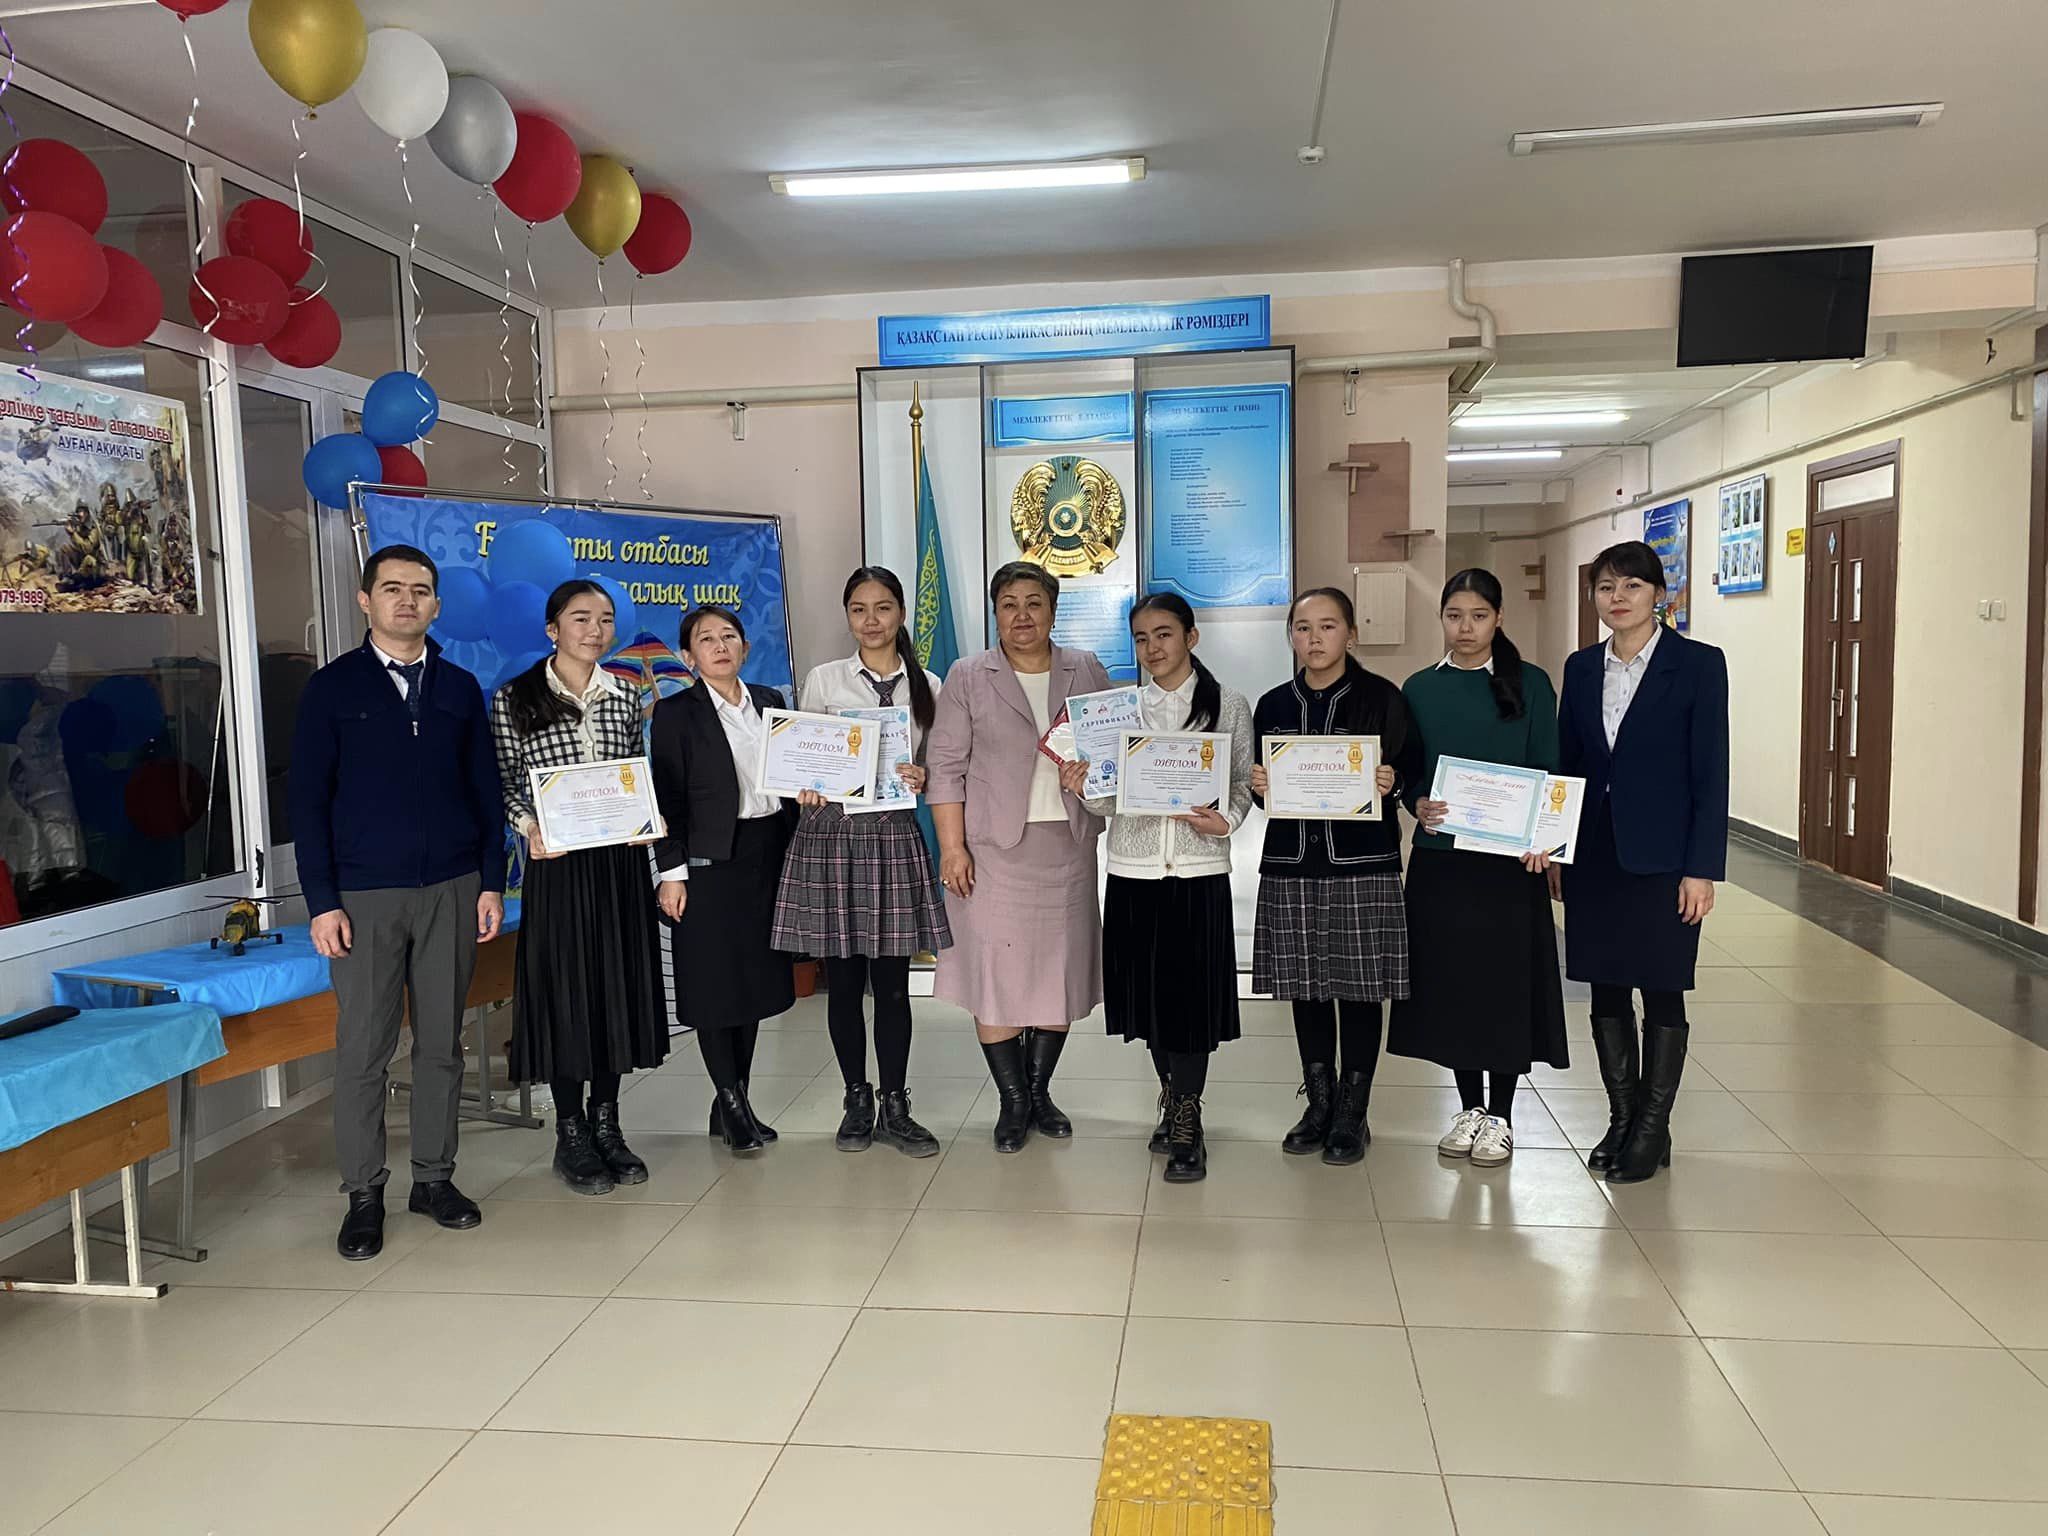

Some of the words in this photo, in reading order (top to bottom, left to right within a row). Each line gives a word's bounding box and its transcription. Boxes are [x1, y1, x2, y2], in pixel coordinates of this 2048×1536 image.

[897, 329, 964, 346] ҚАЗАҚСТАН
[967, 318, 1094, 342] РЕСПУБЛИКАСЫНЫҢ
[1186, 312, 1249, 330] РӘМІЗДЕРІ
[58, 435, 94, 452] АУҒАН
[96, 441, 144, 460] АҚИҚАТЫ
[620, 535, 709, 566] отбасы
[0, 590, 43, 604] 79-1989
[693, 583, 742, 611] шақ
[798, 741, 844, 754] ДИПЛОМ
[1153, 759, 1198, 769] ДИПЛОМ
[1298, 763, 1346, 772] ДИПЛОМ
[573, 787, 619, 800] ДИПЛОМ
